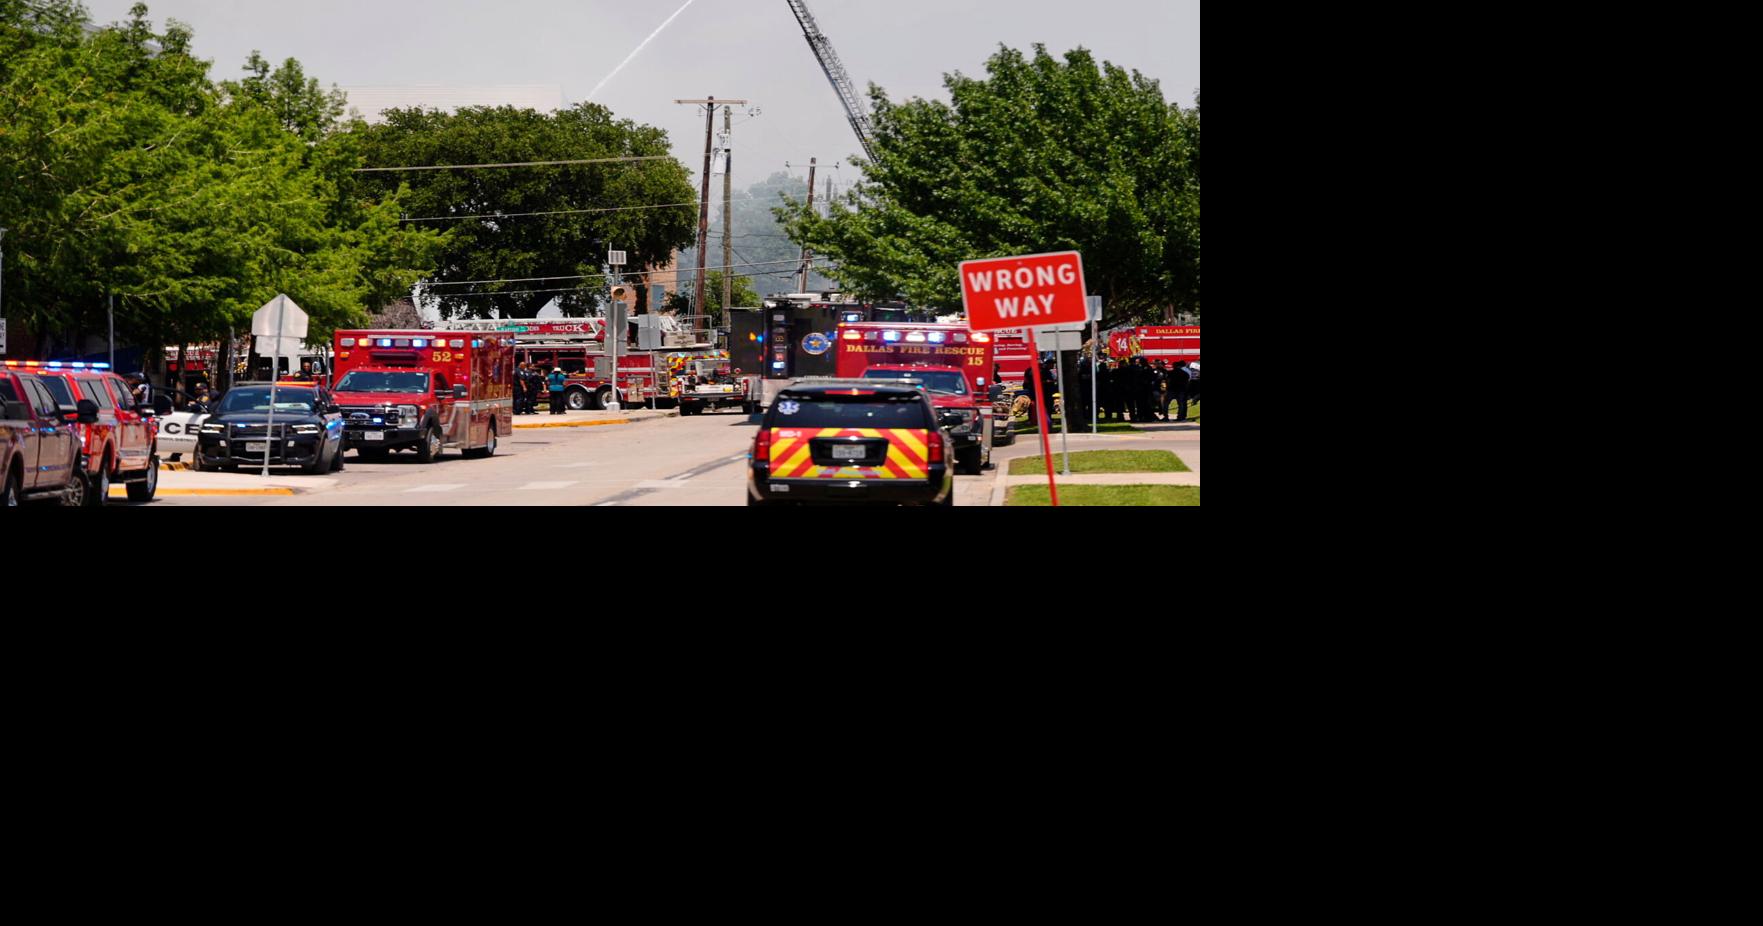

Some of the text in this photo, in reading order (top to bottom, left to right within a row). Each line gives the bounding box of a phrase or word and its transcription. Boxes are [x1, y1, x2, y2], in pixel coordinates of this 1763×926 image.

[968, 263, 1076, 293] WRONG
[994, 293, 1055, 319] WAY
[552, 324, 586, 332] TRUCK
[846, 344, 985, 356] DALLAS FIRE RESCUE
[1116, 338, 1128, 352] 14
[432, 351, 452, 363] 52
[967, 357, 984, 366] 15
